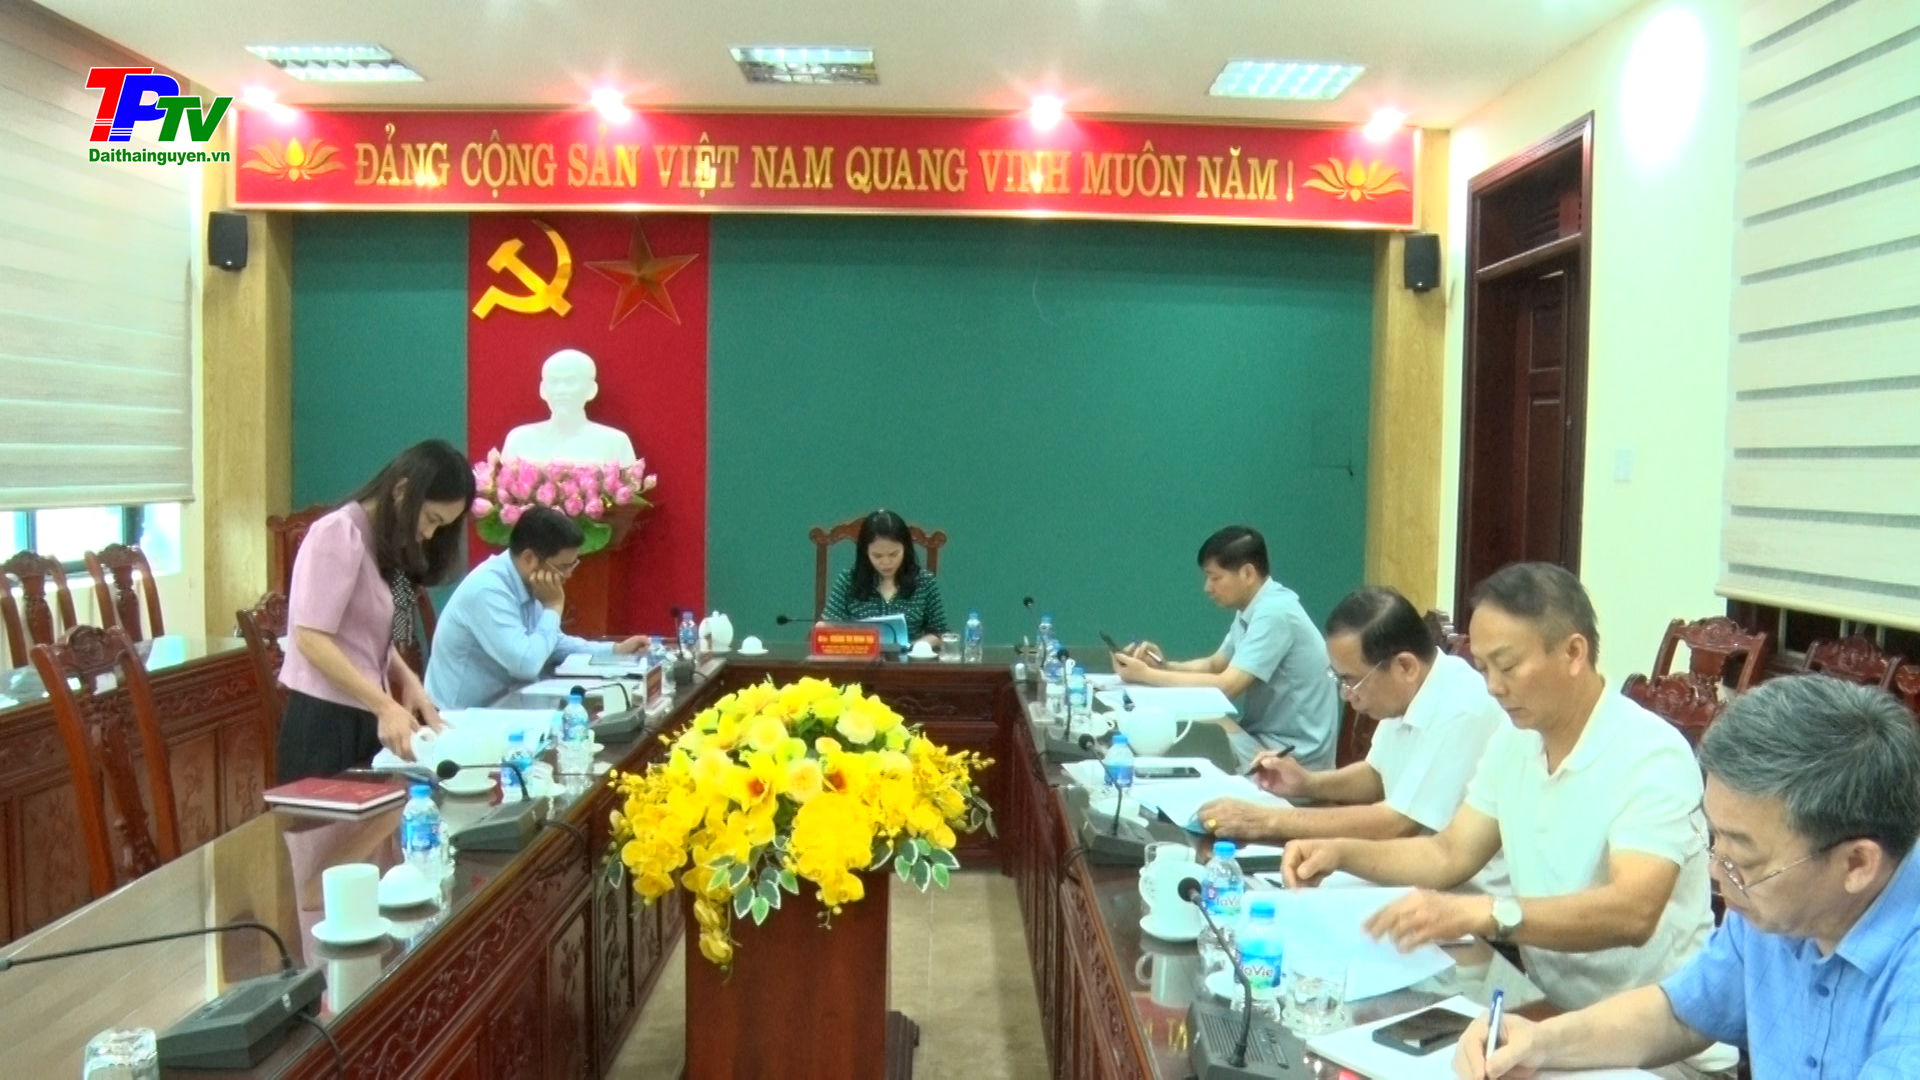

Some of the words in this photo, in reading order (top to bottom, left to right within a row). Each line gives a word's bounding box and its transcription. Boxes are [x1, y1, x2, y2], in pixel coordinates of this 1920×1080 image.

[354, 122, 451, 187] ĐẢNG
[460, 129, 558, 199] CỘNG
[653, 131, 740, 199] VIỆT
[751, 145, 835, 190] NAM
[845, 145, 969, 194] QUANG
[978, 149, 1072, 194] VINH
[1081, 139, 1187, 198] MUÔN
[1196, 145, 1278, 201] NĂM
